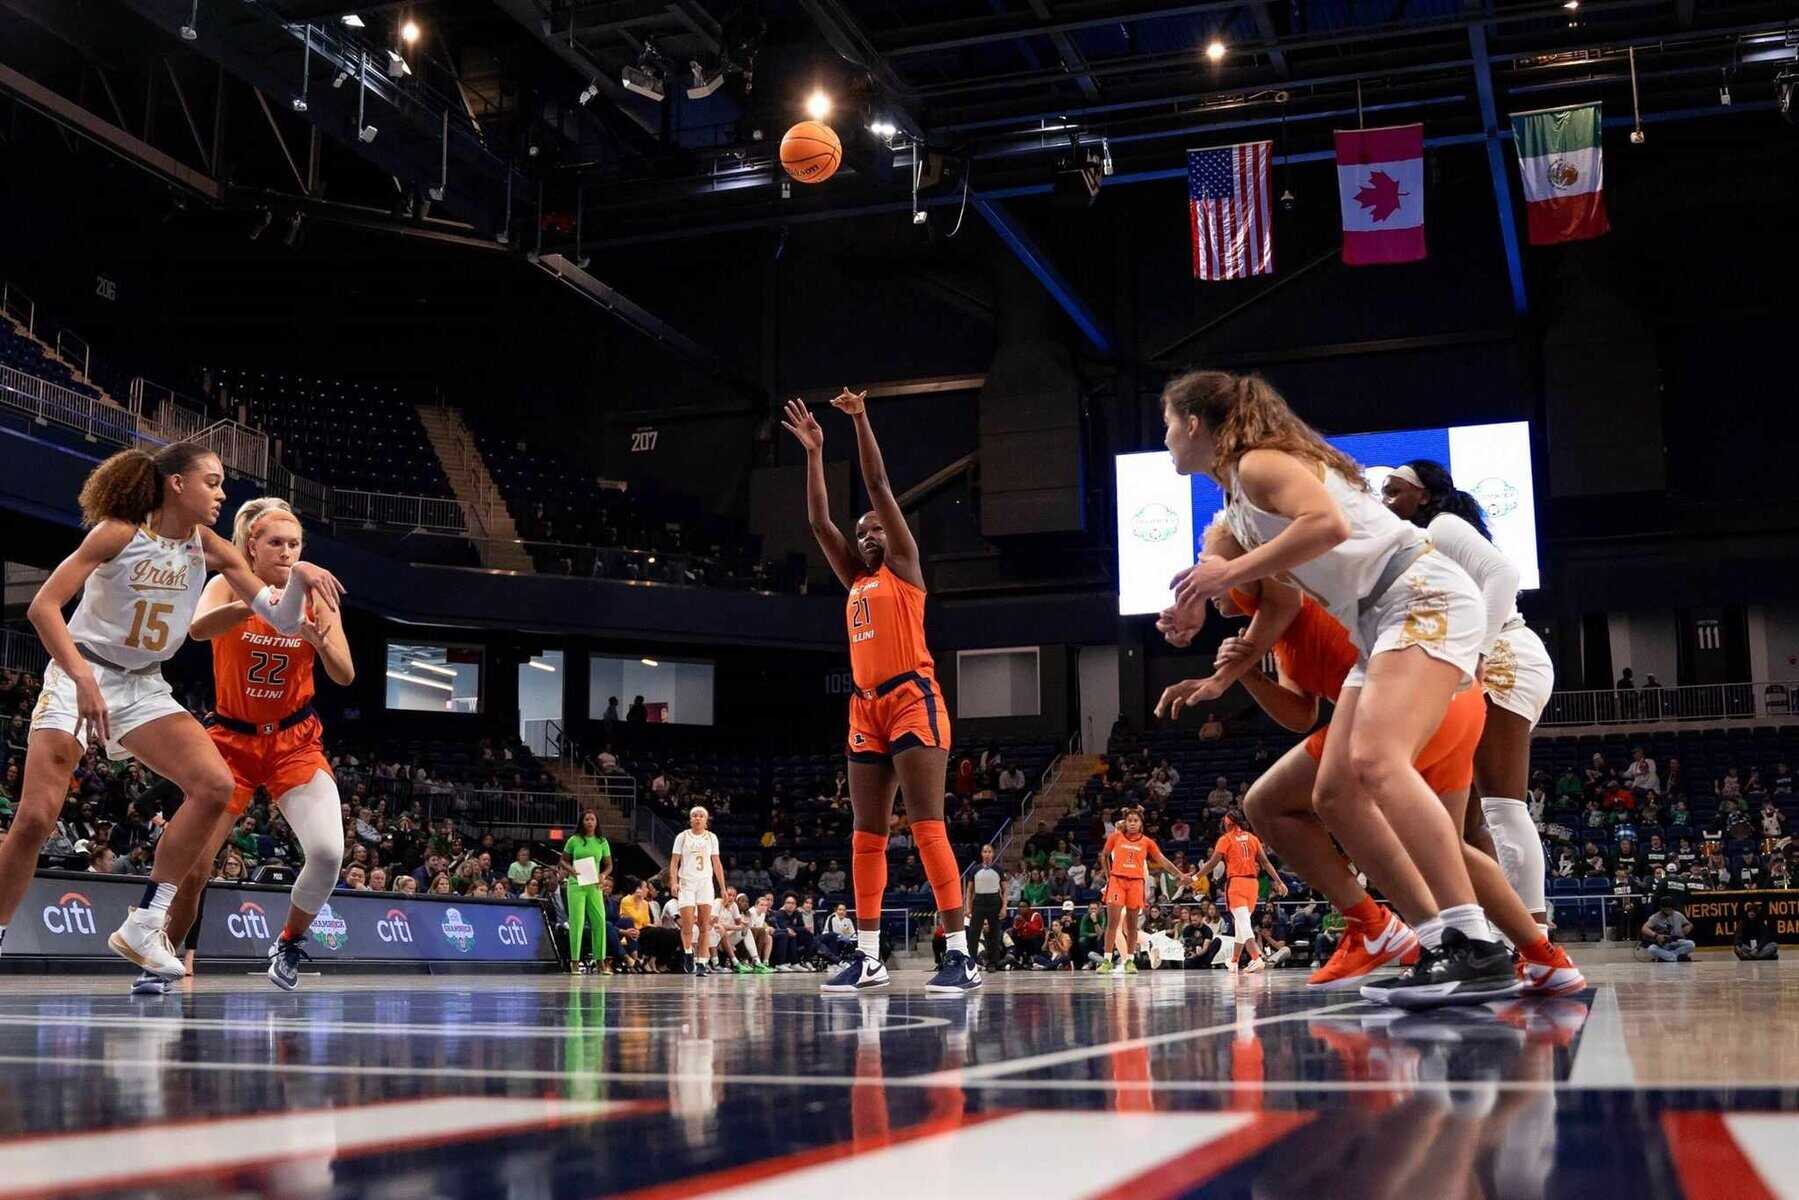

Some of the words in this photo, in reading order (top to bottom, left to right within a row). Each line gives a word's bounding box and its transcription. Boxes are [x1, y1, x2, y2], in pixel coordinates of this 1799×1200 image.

[96, 276, 116, 301] 206
[631, 431, 658, 451] 207
[129, 559, 188, 586] Irish
[852, 597, 872, 628] 21
[124, 599, 175, 652] 15
[1697, 626, 1720, 649] 111
[241, 631, 302, 648] FIGHTING
[247, 650, 289, 685] 22
[245, 687, 285, 699] ILLINI
[695, 855, 704, 871] 3
[43, 901, 97, 935] citi
[1684, 902, 1738, 918] VERSITY
[227, 909, 271, 940] citi
[377, 916, 413, 942] citi
[498, 921, 528, 945] citi
